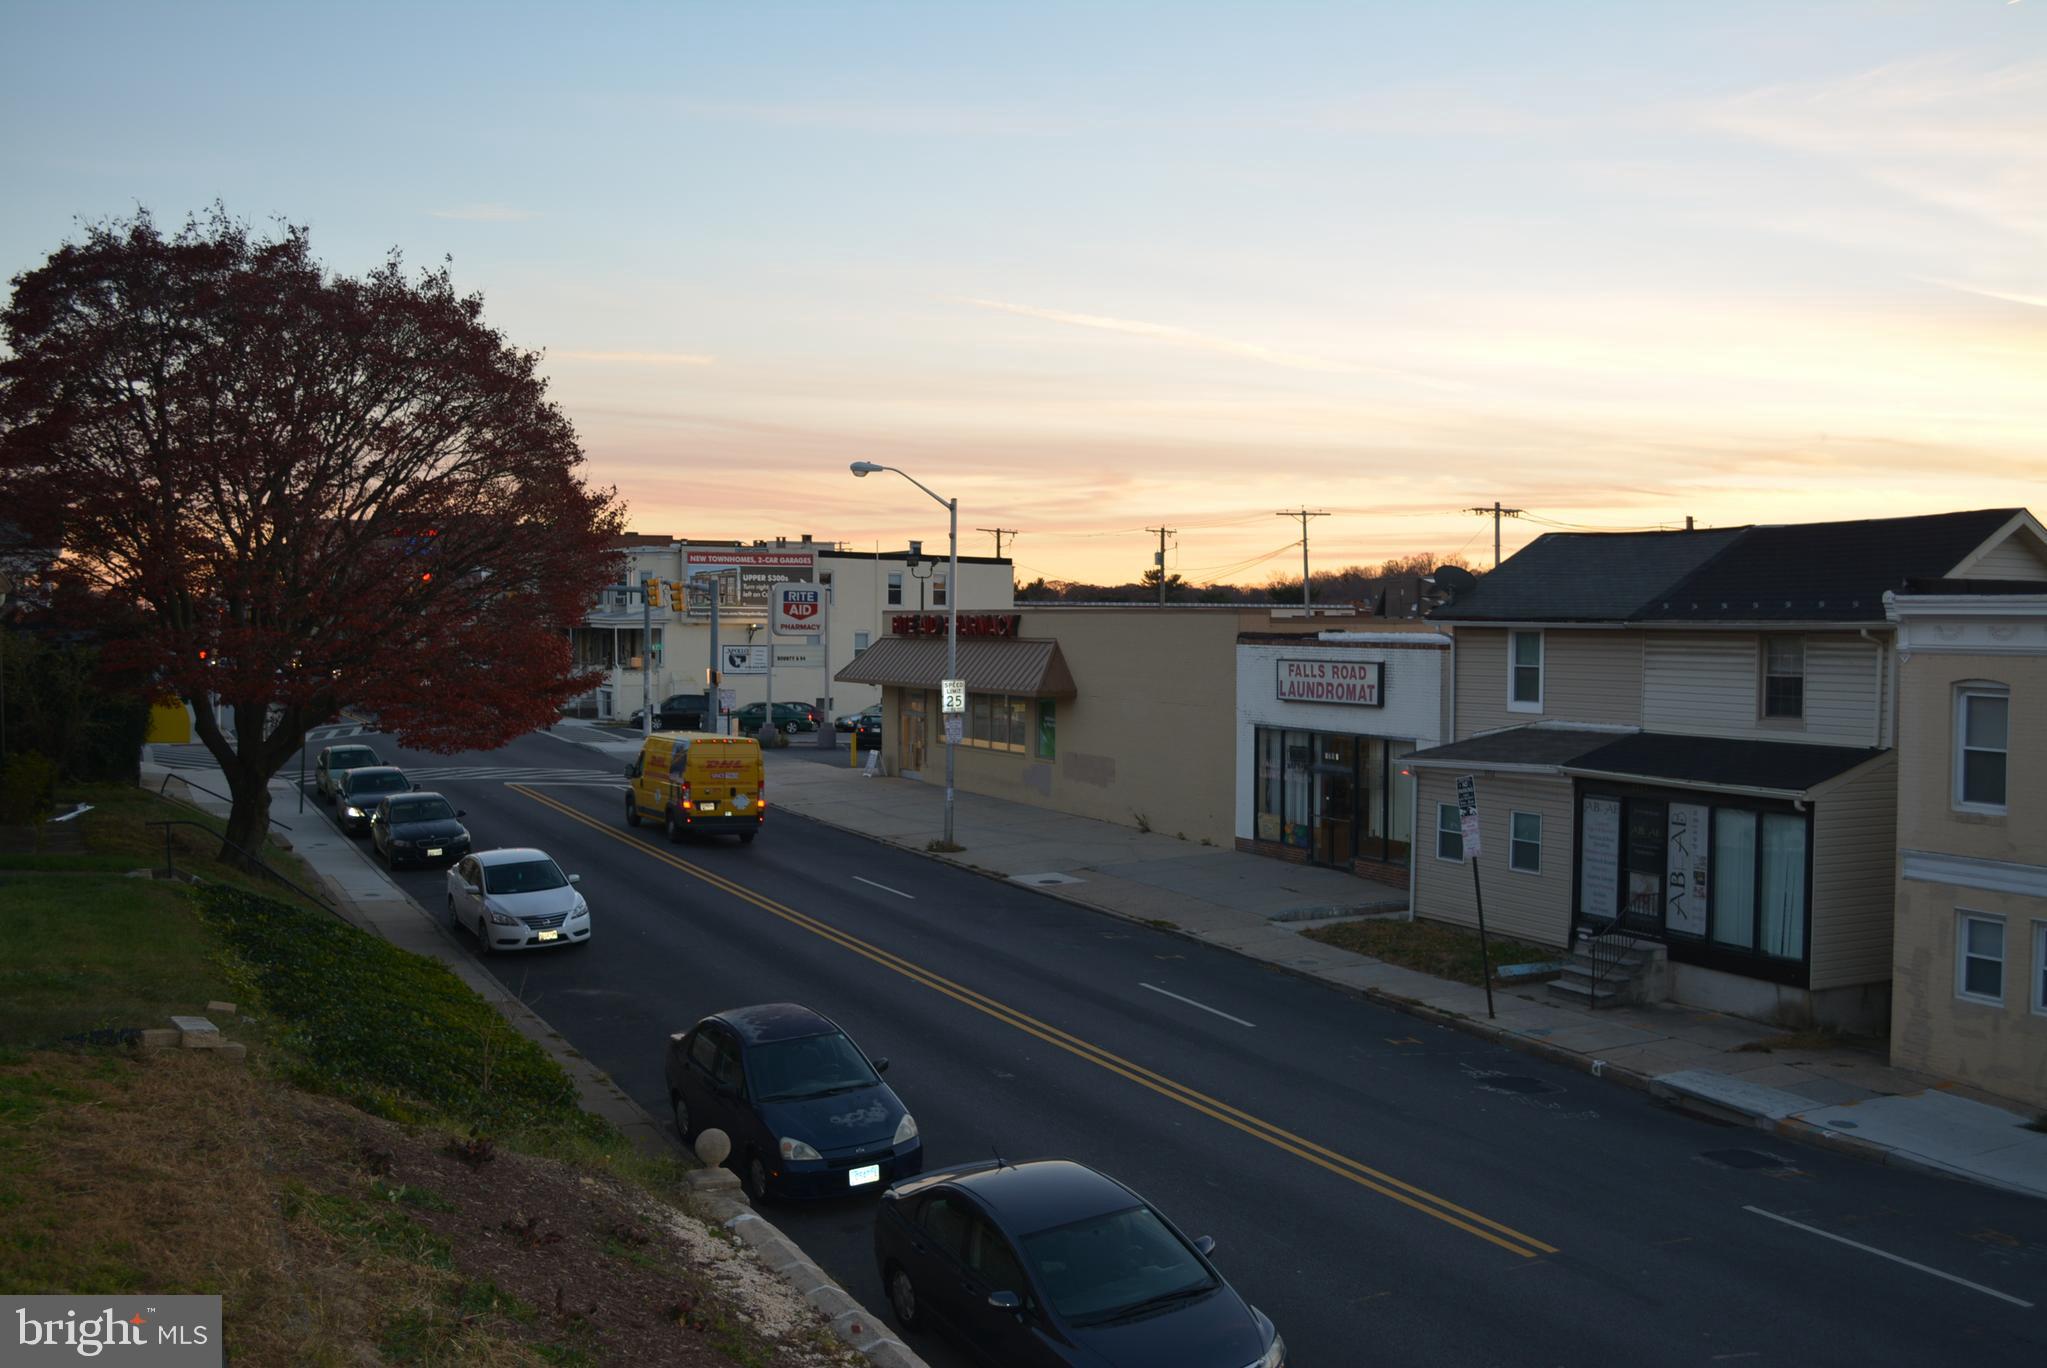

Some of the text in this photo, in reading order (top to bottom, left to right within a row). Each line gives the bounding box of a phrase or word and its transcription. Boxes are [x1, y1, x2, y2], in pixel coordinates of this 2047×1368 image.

[708, 555, 756, 563] TOWNHOMES,
[758, 556, 779, 564] 2-CAR
[742, 574, 789, 582] UPPER $300s
[787, 591, 815, 602] RITE
[789, 604, 812, 616] AID
[1288, 663, 1367, 680] FALLS ROAD
[1279, 680, 1375, 702] LAUNDROMAT
[946, 695, 962, 708] 25
